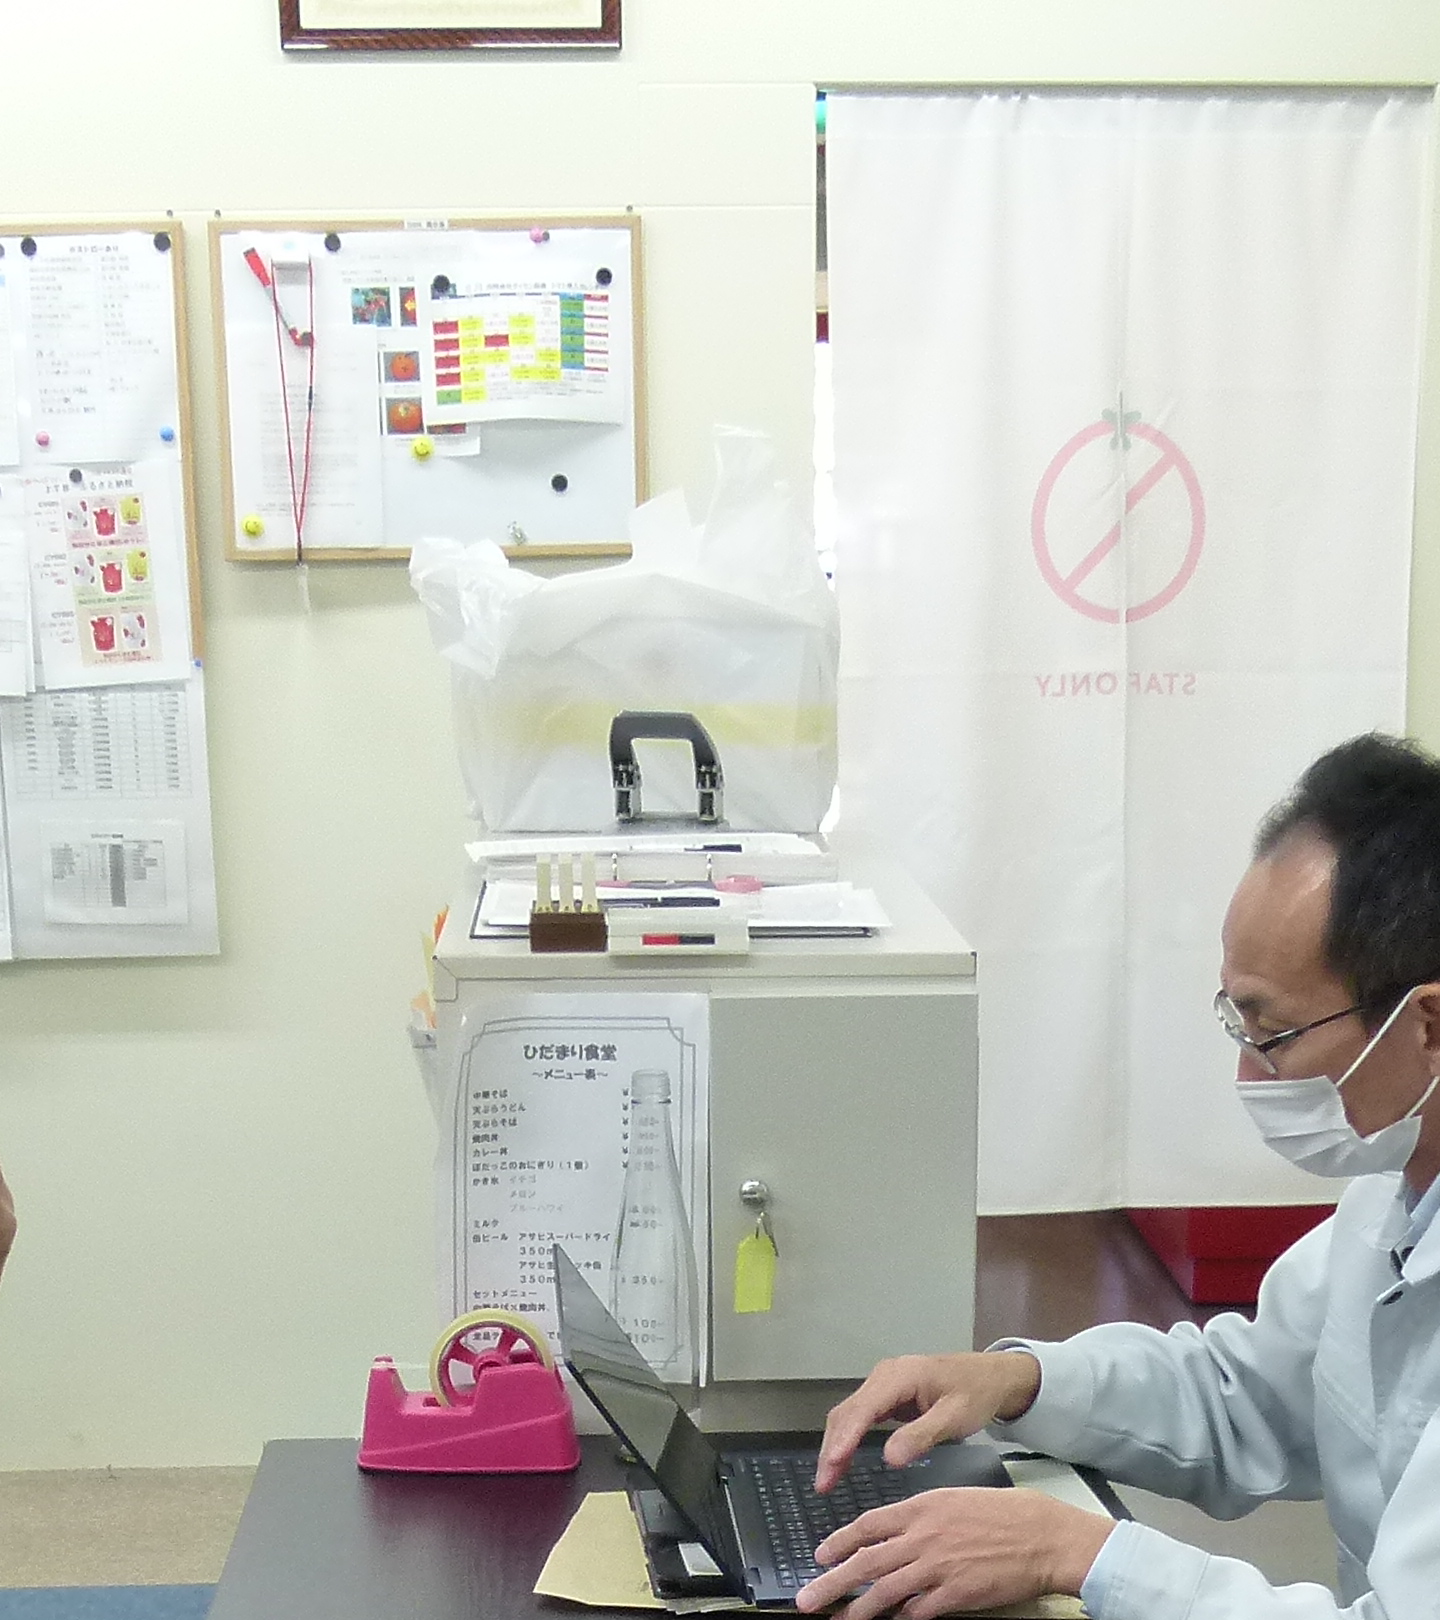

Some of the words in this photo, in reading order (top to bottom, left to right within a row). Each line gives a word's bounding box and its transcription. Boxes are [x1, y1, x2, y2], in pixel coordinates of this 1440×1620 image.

[522, 1043, 618, 1062] ひだまり食堂
[472, 1088, 509, 1100] 中華そば
[472, 1102, 527, 1115] 天ぷらうどん
[472, 1117, 518, 1129] 天ぷらそば
[472, 1132, 499, 1144] 焼肉丼
[472, 1146, 509, 1158] カレー丼
[472, 1175, 500, 1186] かき氷
[509, 1189, 536, 1199] メロン
[473, 1219, 499, 1230] ミルク
[472, 1232, 509, 1244] 缶ビール
[518, 1231, 611, 1243] アサヒスーパードライ
[472, 1289, 538, 1299] セットメニュー
